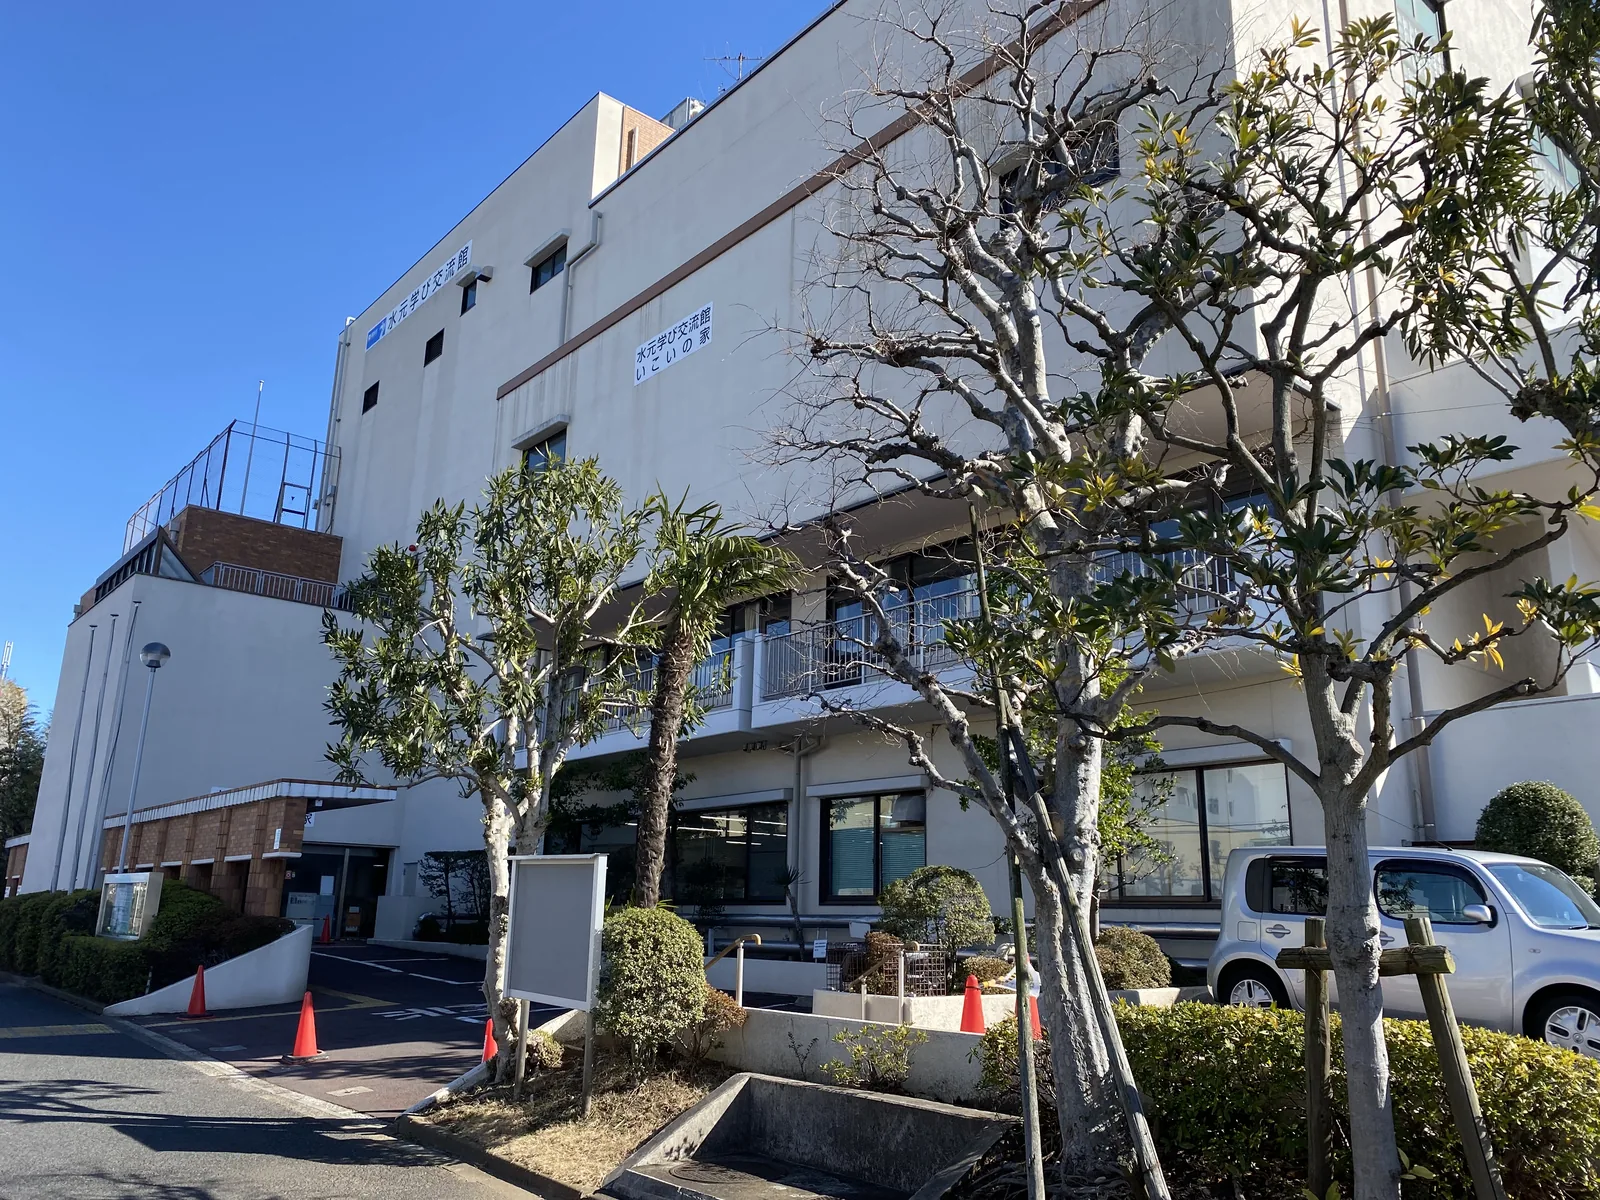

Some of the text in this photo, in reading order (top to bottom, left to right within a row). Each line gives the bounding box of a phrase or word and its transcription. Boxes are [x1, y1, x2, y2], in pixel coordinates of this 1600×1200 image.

[387, 246, 469, 330] 水元学び交流館
[636, 307, 711, 363] 水元学び交流館
[636, 326, 710, 381] いこいの家
